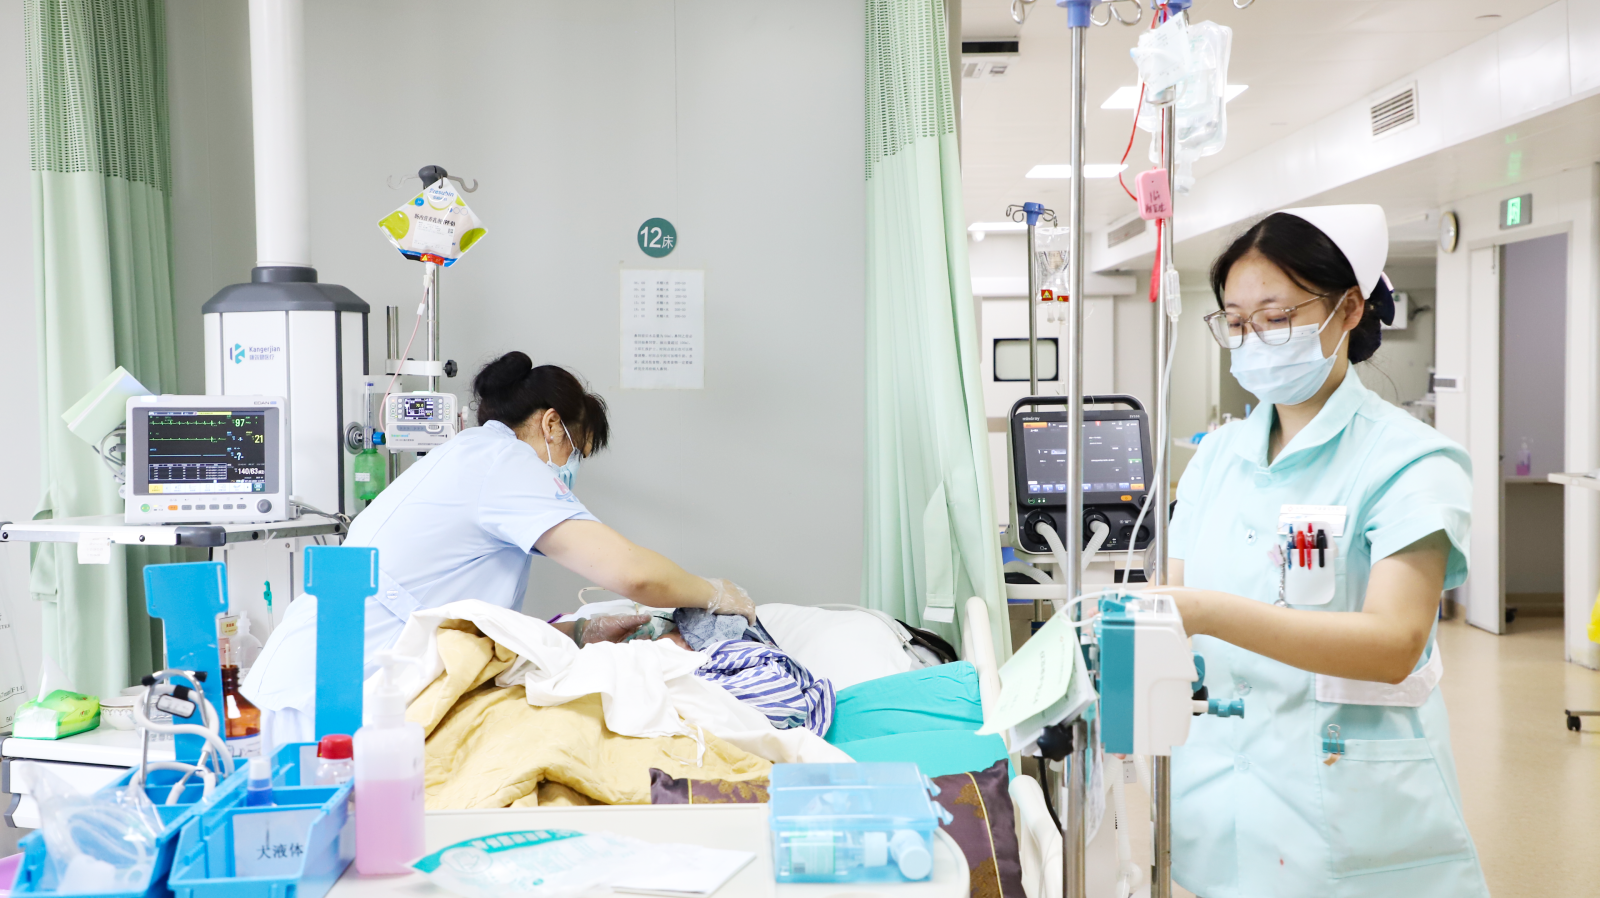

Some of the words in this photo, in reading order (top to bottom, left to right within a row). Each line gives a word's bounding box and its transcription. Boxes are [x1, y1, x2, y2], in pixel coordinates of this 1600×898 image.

[640, 226, 674, 249] 12床
[249, 345, 281, 354] Kangerjian
[235, 418, 245, 428] 97
[254, 434, 264, 444] 21
